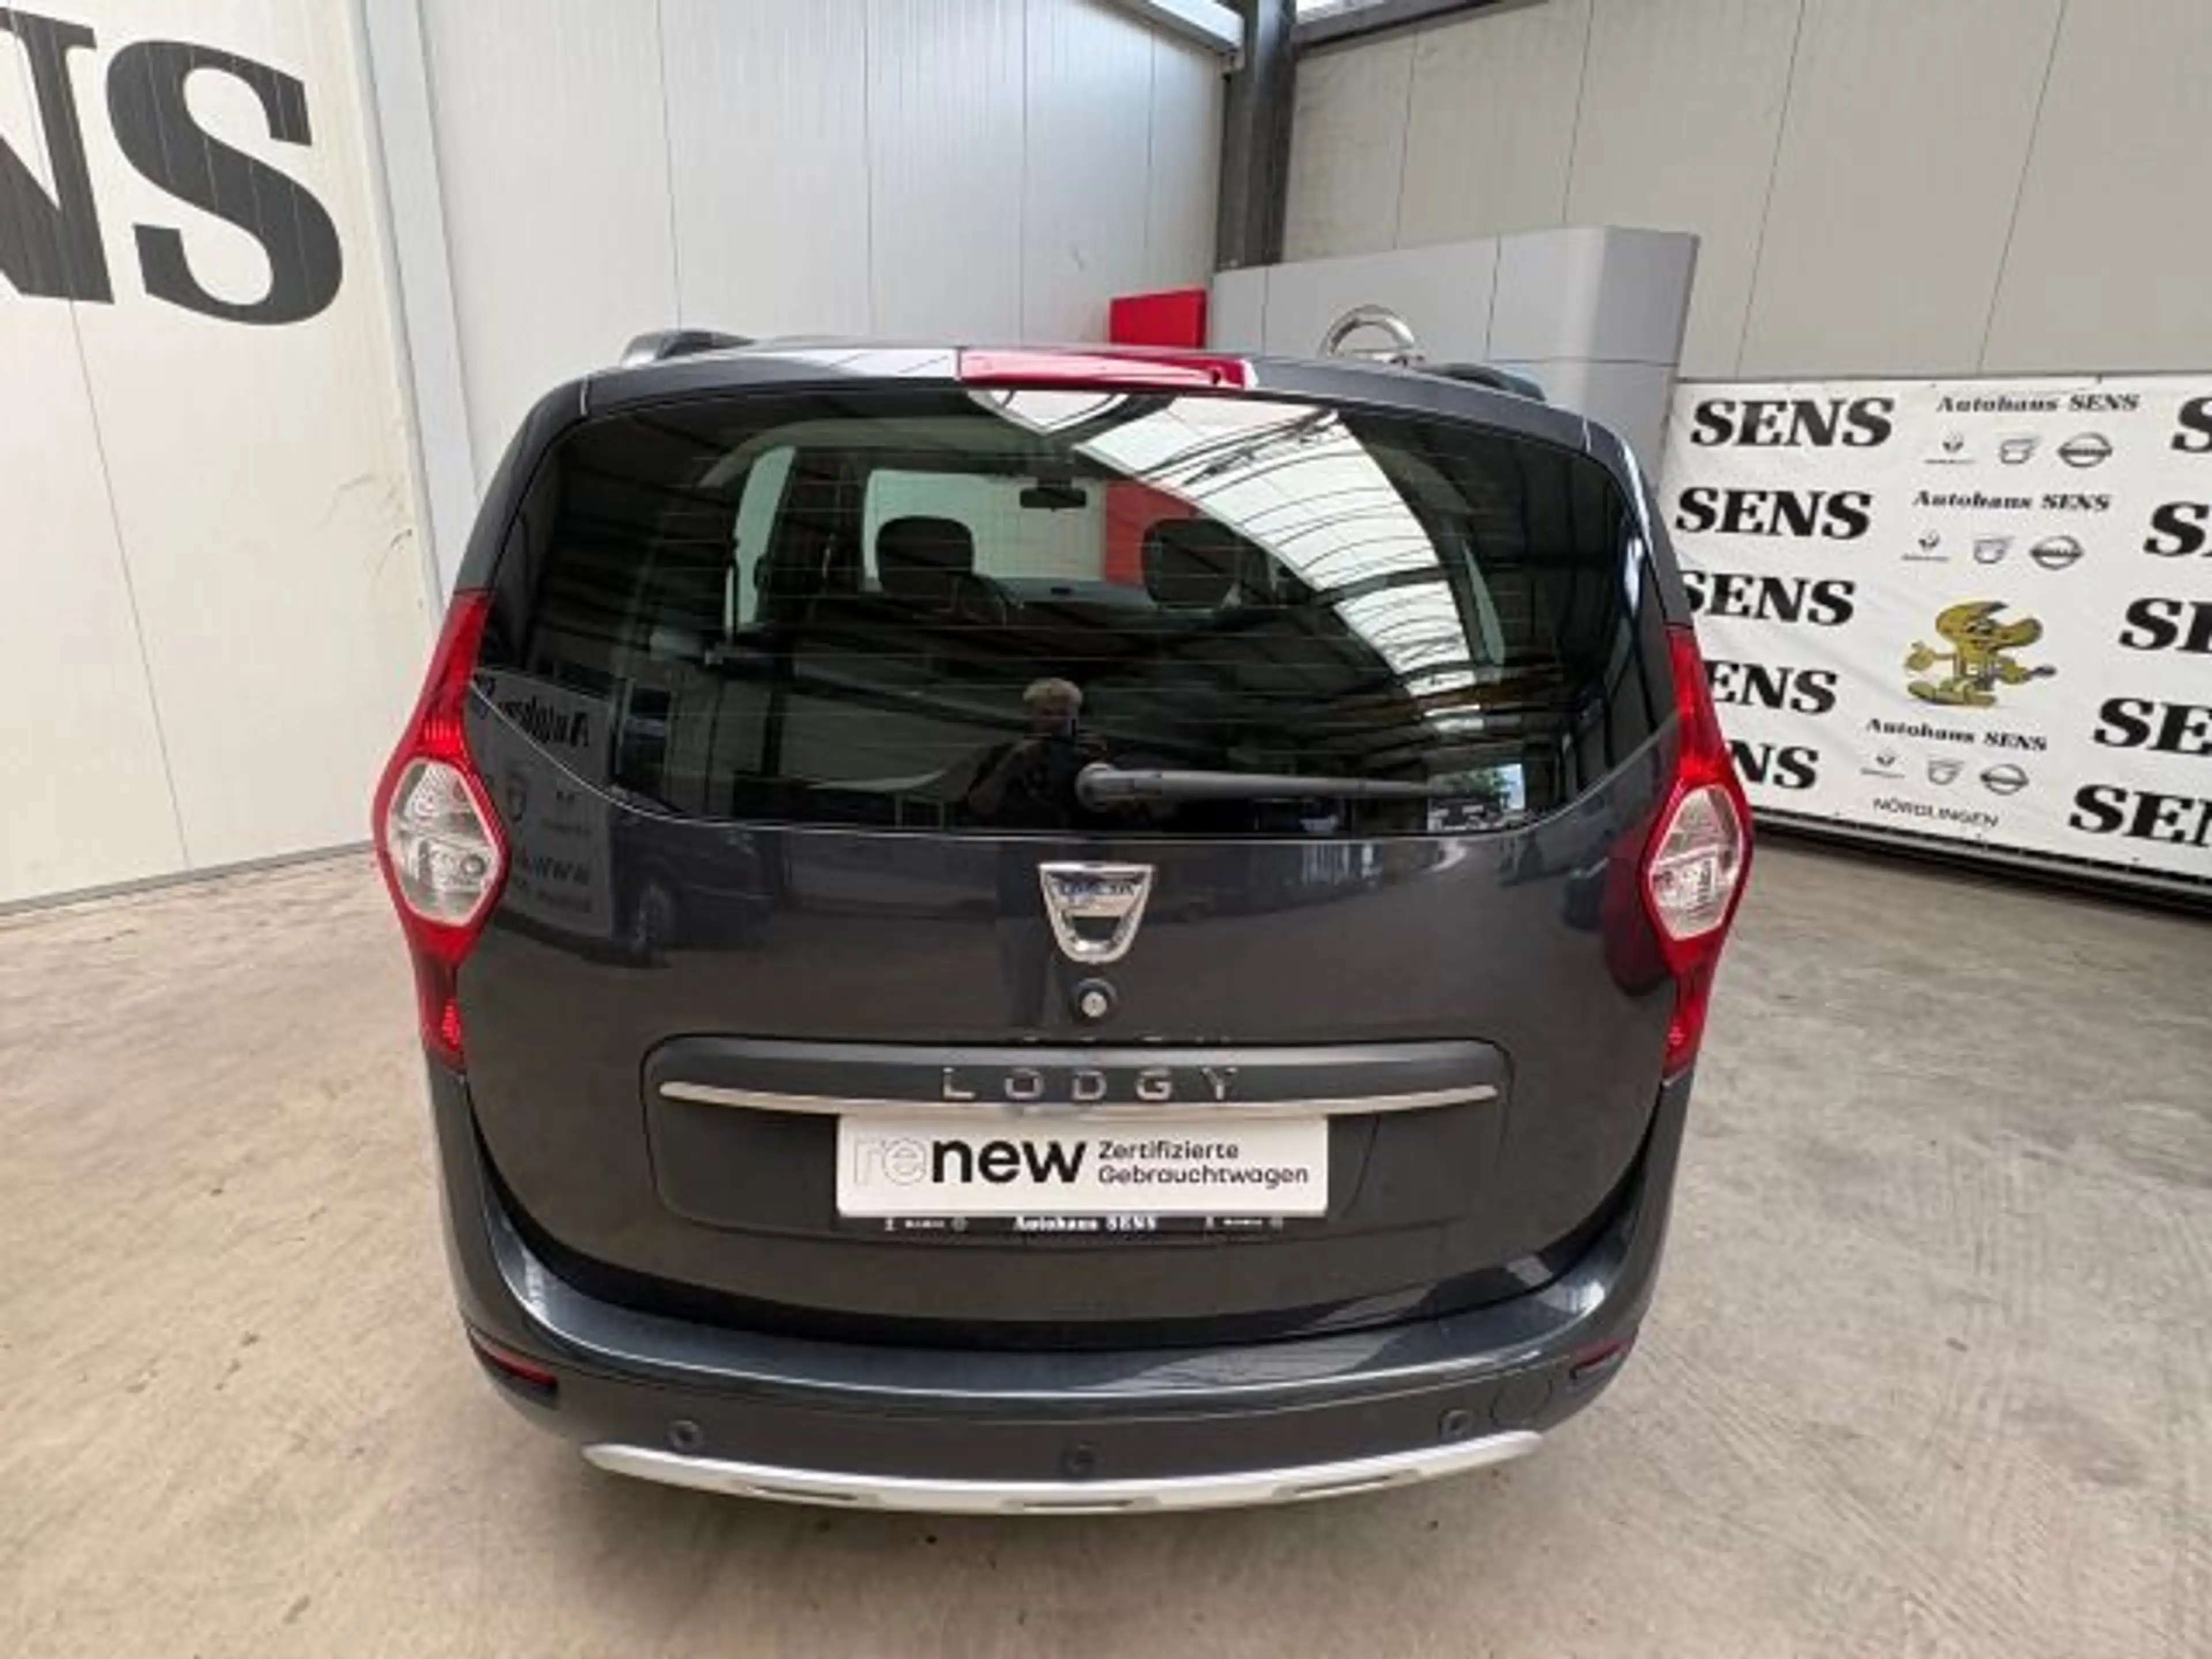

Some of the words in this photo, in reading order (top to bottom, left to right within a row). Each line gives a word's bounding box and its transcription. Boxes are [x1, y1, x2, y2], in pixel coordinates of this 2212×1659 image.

[0, 7, 343, 325] NS
[1936, 395, 2059, 413] Autohaus
[2069, 393, 2141, 412] SENS
[1690, 397, 1895, 448] SENS
[1675, 486, 1872, 540] SENS
[1912, 490, 2033, 510] Autohaus
[2041, 493, 2111, 512] SENS
[1866, 718, 1975, 744] Autohaus
[1983, 731, 2048, 752] SENS
[942, 1066, 1238, 1101] LODGY
[1098, 1140, 1239, 1161] Zertifizierte
[1098, 1165, 1309, 1190] Gebrauchtwagen
